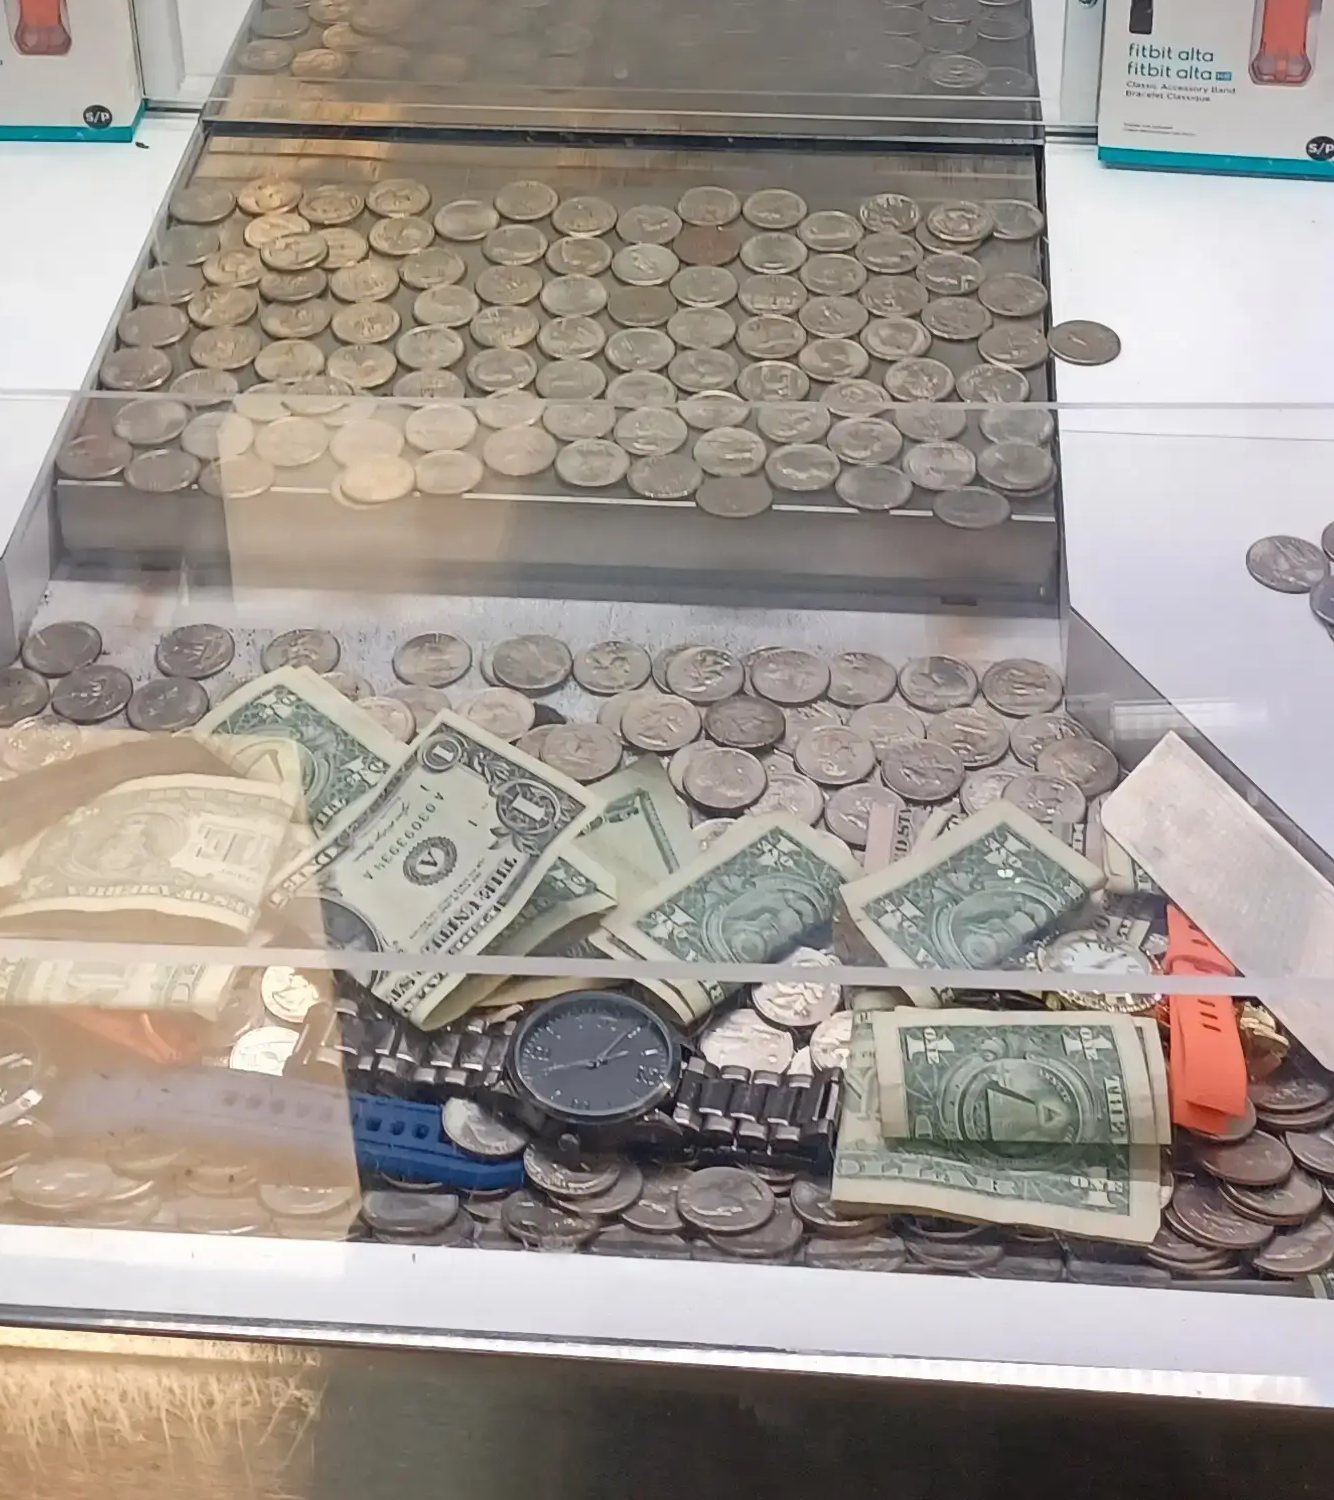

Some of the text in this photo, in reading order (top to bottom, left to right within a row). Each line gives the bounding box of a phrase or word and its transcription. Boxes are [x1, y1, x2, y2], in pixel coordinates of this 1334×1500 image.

[1128, 42, 1215, 63] fitbit alta
[1126, 60, 1172, 79] fitbit
[1175, 64, 1213, 81] alta
[1160, 82, 1209, 94] Accessory
[84, 110, 111, 125] S/P
